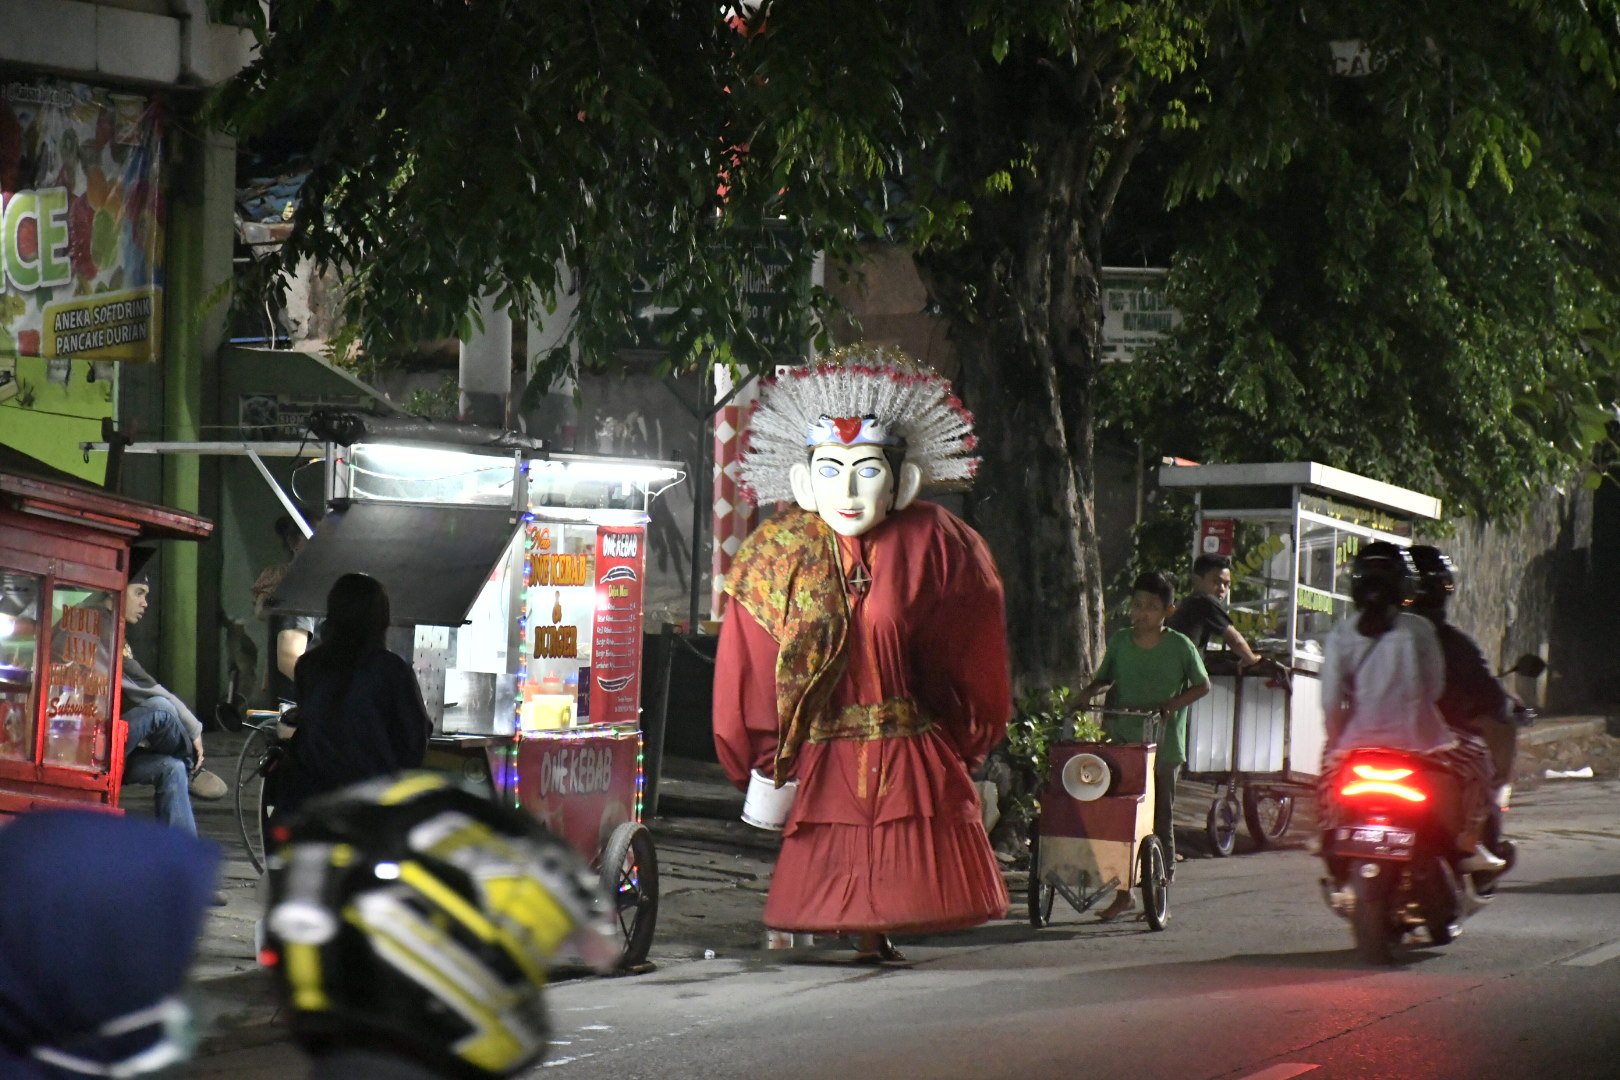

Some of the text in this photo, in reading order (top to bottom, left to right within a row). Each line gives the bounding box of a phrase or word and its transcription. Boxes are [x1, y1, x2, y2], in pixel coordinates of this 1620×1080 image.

[54, 297, 151, 332] ANEKA SOFTDRINK
[55, 322, 147, 355] PANCAKE DURIAN
[550, 553, 587, 587] KEBAB
[60, 604, 101, 636] BUBUR
[62, 636, 97, 667] AYAM
[533, 625, 578, 659] BURGER
[540, 746, 613, 797] ONE KEBAB
